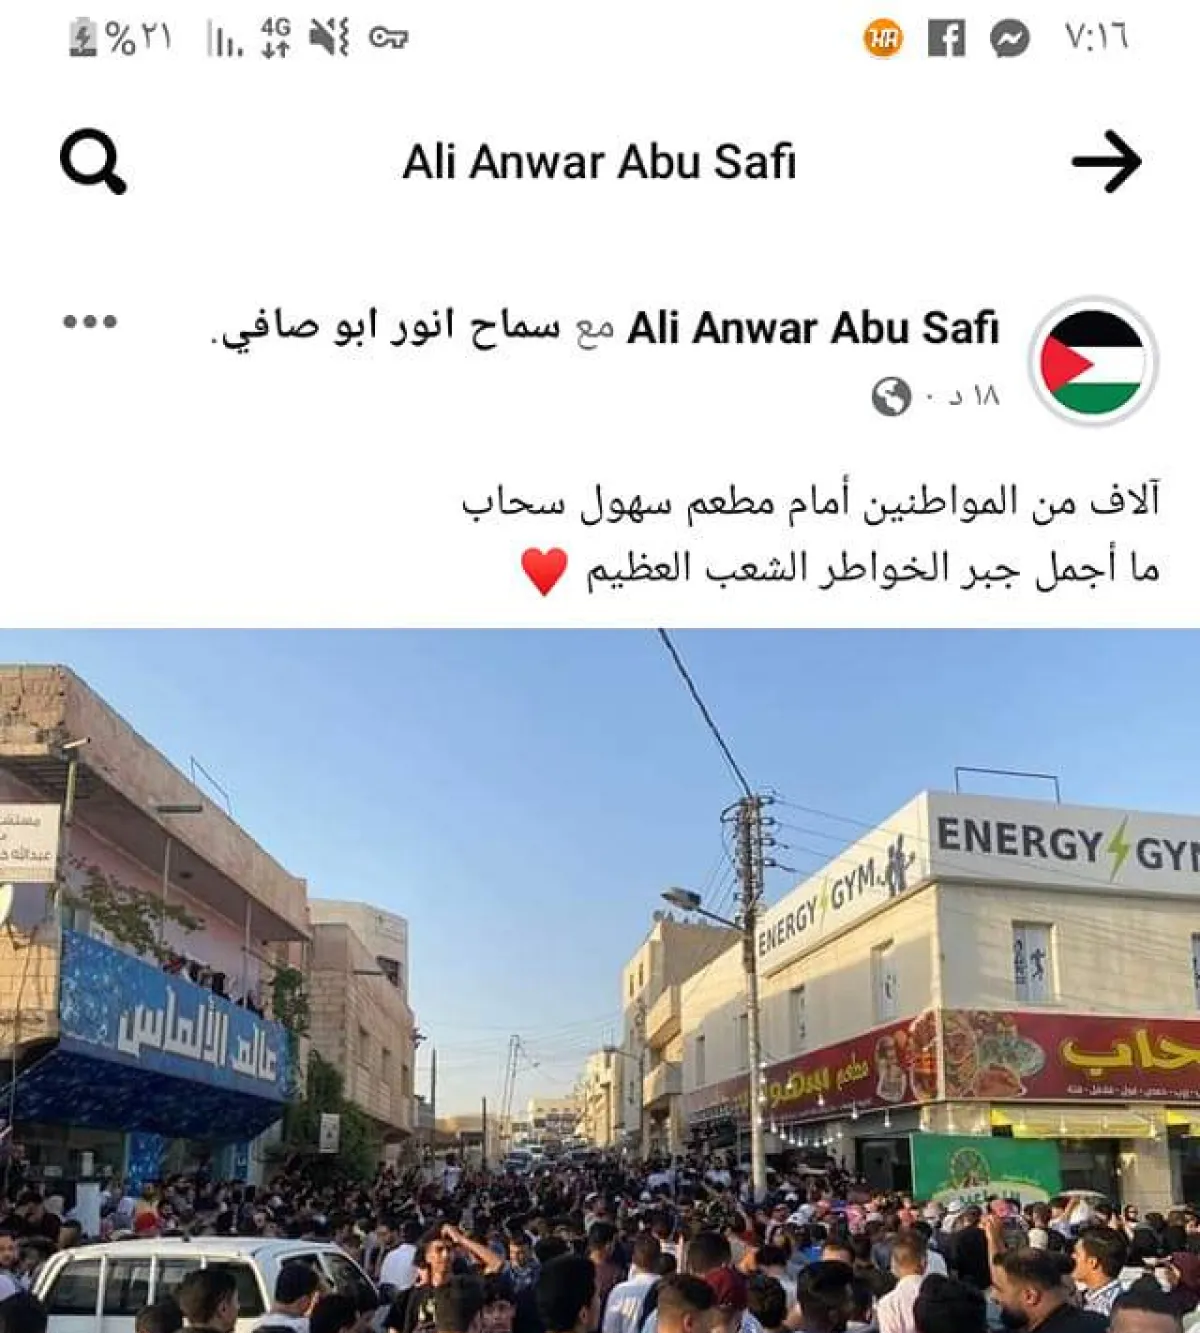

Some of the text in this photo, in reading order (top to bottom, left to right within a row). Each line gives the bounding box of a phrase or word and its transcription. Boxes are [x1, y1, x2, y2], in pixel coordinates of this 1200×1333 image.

[261, 17, 291, 35] 4G
[401, 141, 795, 180] Ali Anwar Abu Safi
[332, 306, 377, 347] ابو
[390, 306, 454, 347] انور
[470, 307, 560, 351] سماح
[576, 320, 613, 351] مع
[626, 309, 679, 345] Ali
[691, 311, 819, 345] Anwar
[829, 309, 909, 345] Abu
[922, 308, 999, 345] Safi
[949, 384, 999, 405] ١٨ د
[463, 474, 1160, 528] آلاف من المواطنين أمام مطعم سهول سحاب
[587, 540, 1159, 594] ما أجمل جبر الخواطر الشعب العظيم
[938, 816, 1200, 872] ENERGY GY
[759, 857, 874, 957] ENERGY GYM
[232, 1022, 277, 1081] عالم
[1062, 1029, 1200, 1077] حاب
